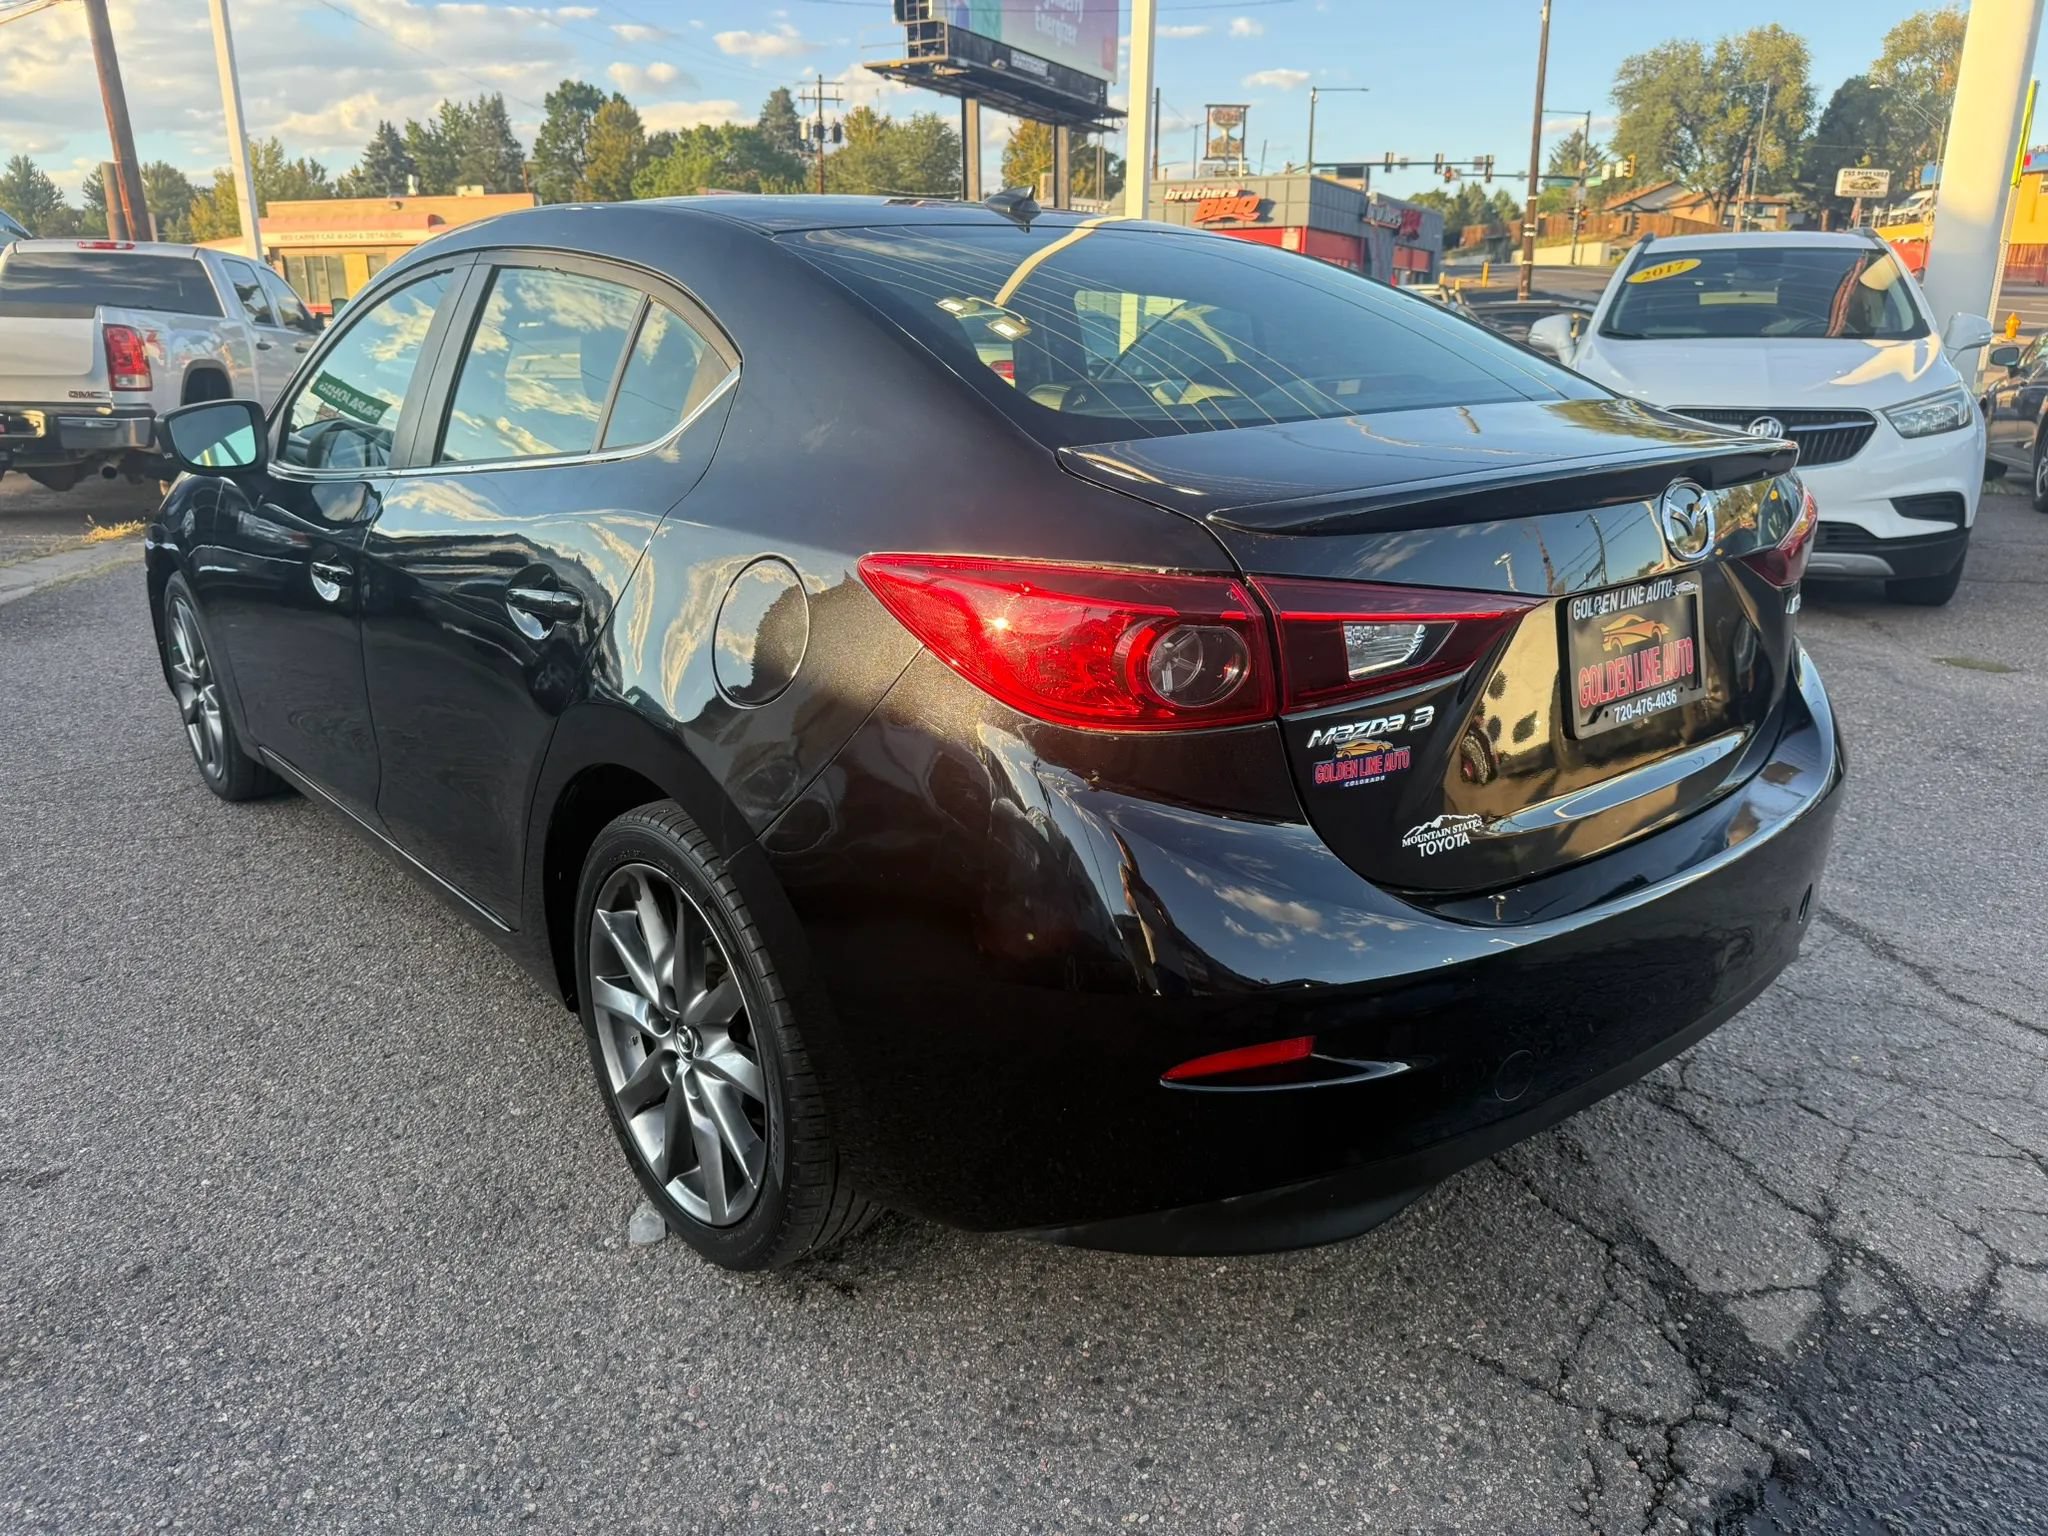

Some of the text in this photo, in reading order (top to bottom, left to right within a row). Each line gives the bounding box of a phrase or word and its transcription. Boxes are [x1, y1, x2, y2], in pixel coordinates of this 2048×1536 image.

[1164, 187, 1239, 200] brothers
[1193, 195, 1260, 223] BBQ
[1643, 261, 1685, 280] 2017
[68, 390, 109, 399] GMC
[1573, 579, 1672, 620] GOLDEN LINE AUTO
[1578, 636, 1694, 708] GOLDEN LINE AUTO
[1407, 705, 1435, 731] 3
[1614, 689, 1678, 723] 720-476-4036
[1315, 750, 1410, 784] GOLDEN LINE AUTO
[1344, 775, 1385, 787] COLORADO
[1402, 819, 1482, 848] MOUNTAIN STATES
[1417, 832, 1471, 857] TOYOTA
